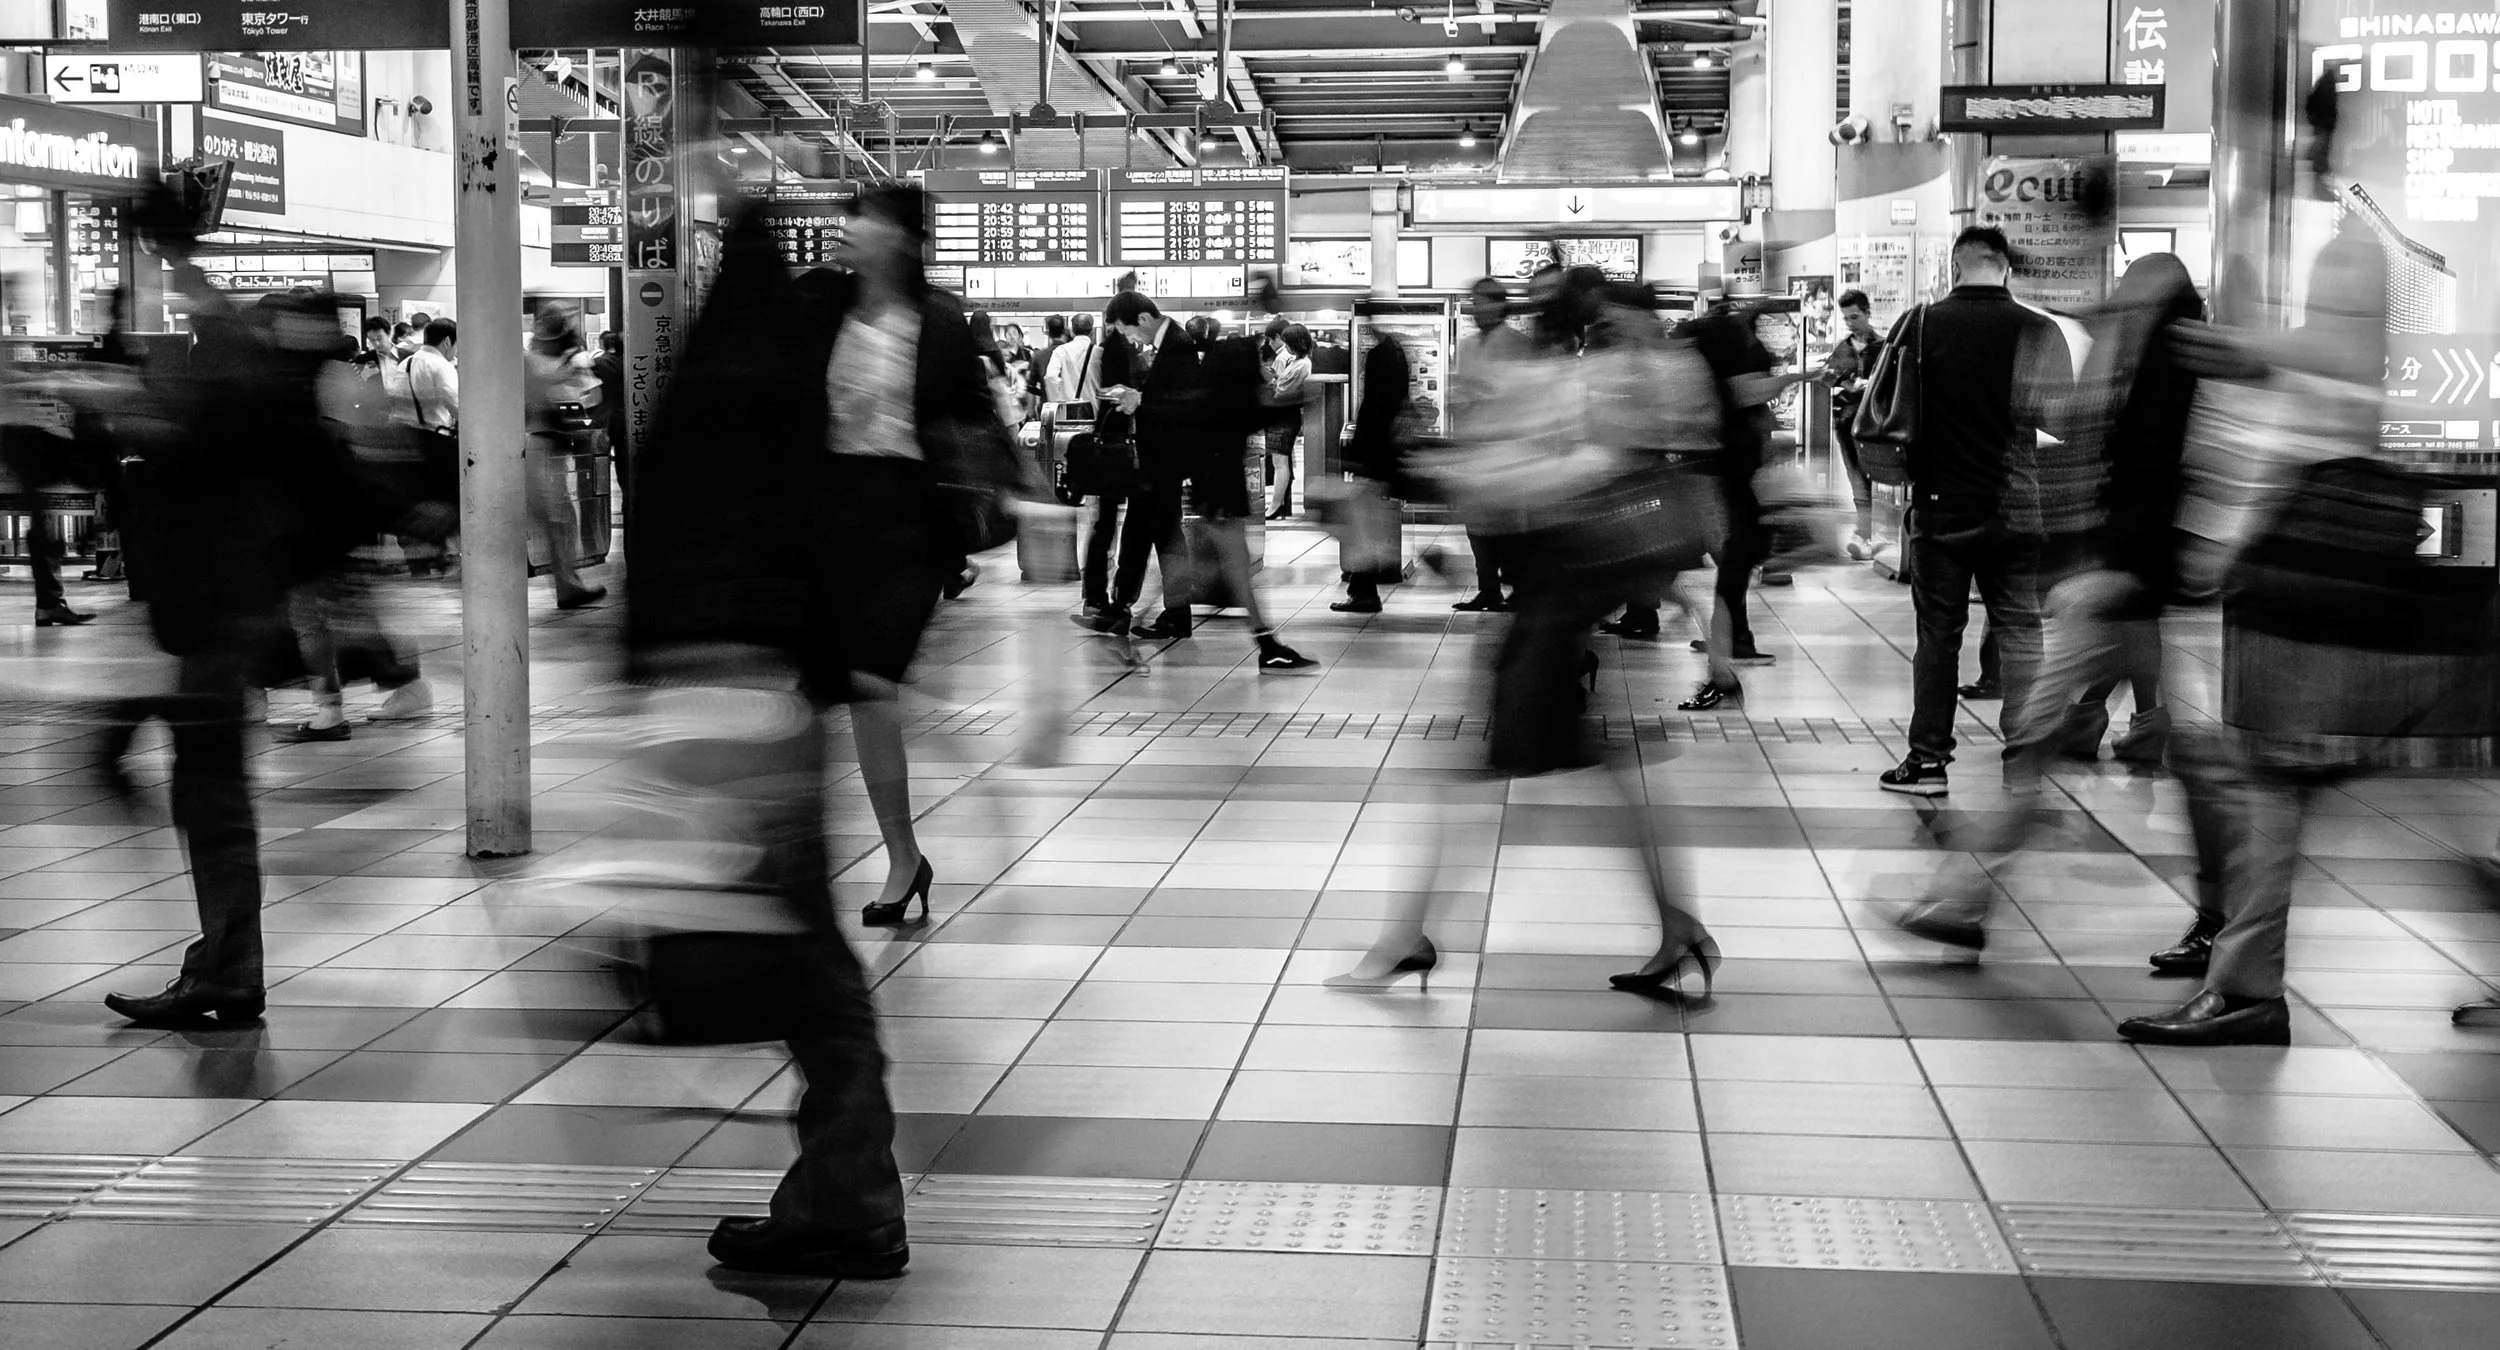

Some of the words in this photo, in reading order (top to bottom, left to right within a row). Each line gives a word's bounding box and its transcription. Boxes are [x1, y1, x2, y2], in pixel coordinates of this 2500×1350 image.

[760, 7, 824, 18] 高輪口（西口）
[241, 13, 309, 25] 東京タワー行
[2340, 13, 2500, 38] SHINAGAW
[2312, 40, 2500, 92] GOO
[203, 135, 278, 166] のりかえ・観光案内
[633, 49, 669, 269] R線のりば
[1985, 169, 2087, 203] ecut
[983, 203, 1014, 214] 20:42
[1169, 201, 1200, 212] 20:50
[983, 215, 1014, 226] 20:52
[1169, 213, 1200, 224] 21:00
[983, 227, 1014, 238] 20:59
[1169, 225, 1200, 236] 21:11
[983, 239, 1014, 249] 21:02
[1169, 237, 1200, 248] 21:20
[983, 251, 1014, 261] 21:10
[1169, 249, 1200, 261] 21:30
[2012, 255, 2096, 266] 越しのお客さまは
[654, 315, 673, 402] 京急線の
